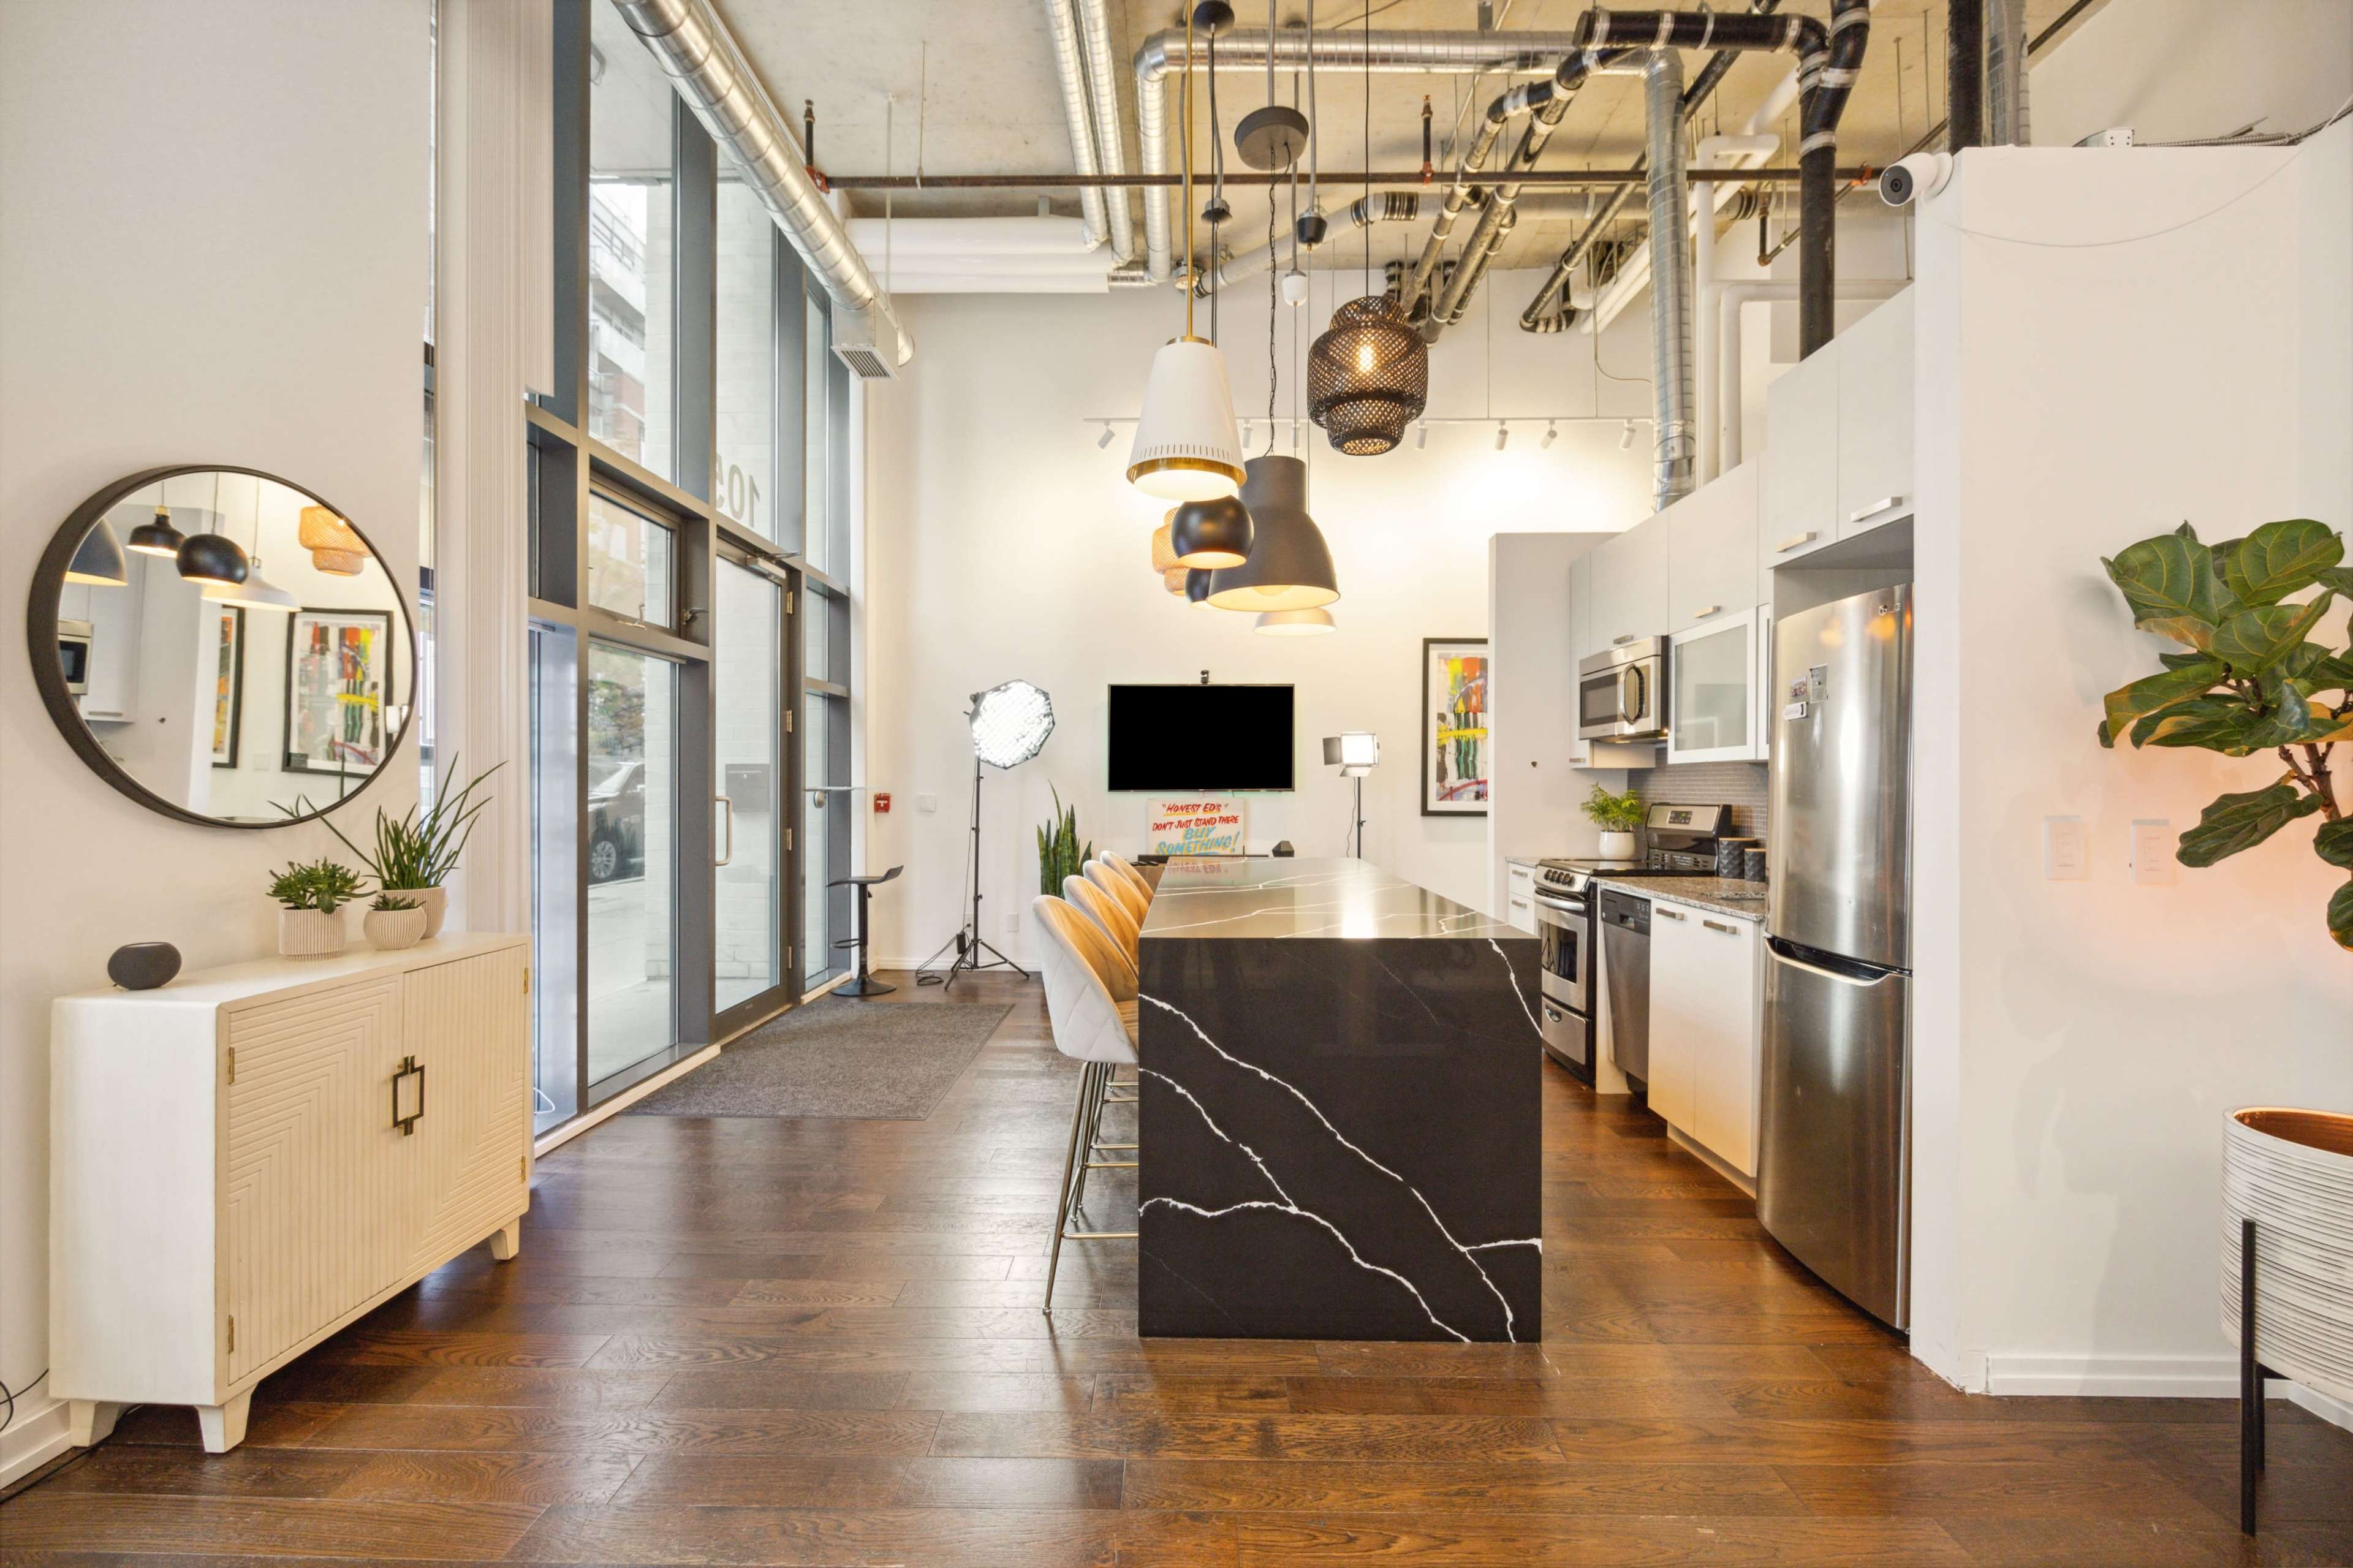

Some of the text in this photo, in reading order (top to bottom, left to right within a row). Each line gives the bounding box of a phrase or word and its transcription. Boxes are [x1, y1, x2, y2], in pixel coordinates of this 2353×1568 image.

[1152, 815, 1240, 831] DON'T JUST STAND THERE
[1182, 826, 1216, 841] BUY
[1155, 831, 1240, 855] SOMETHING!
